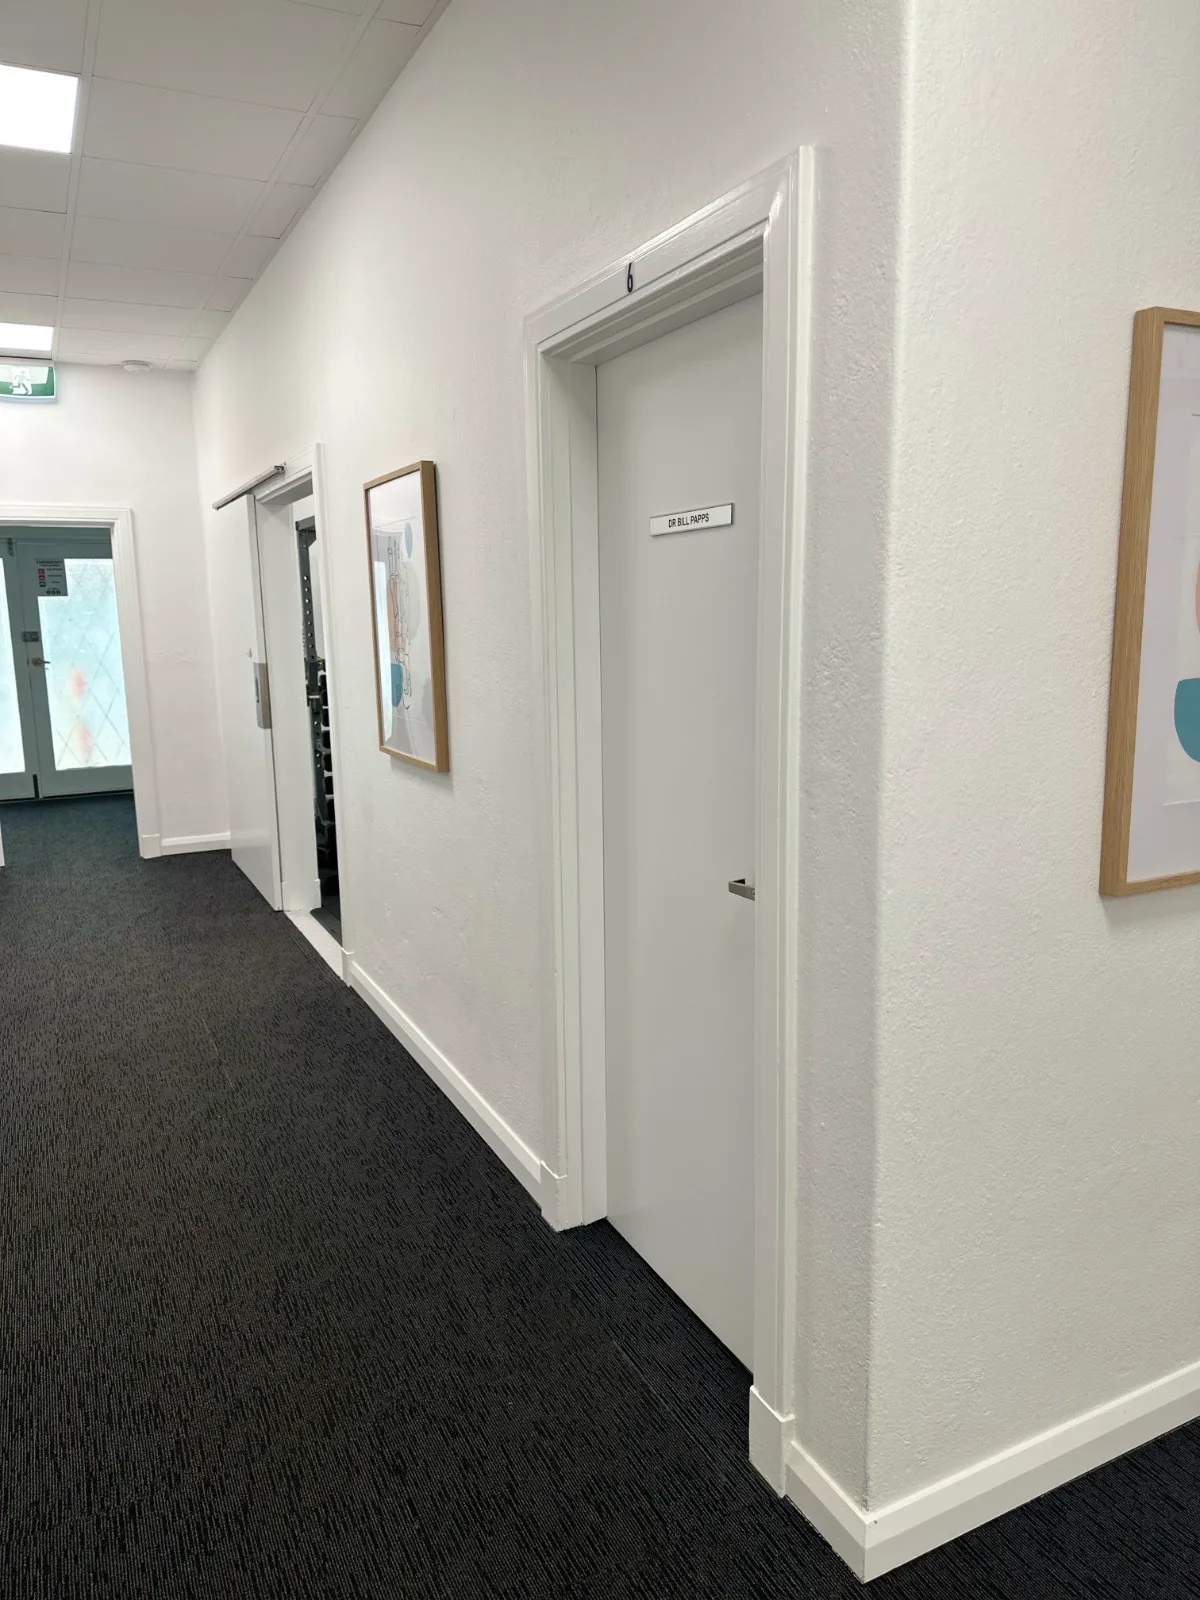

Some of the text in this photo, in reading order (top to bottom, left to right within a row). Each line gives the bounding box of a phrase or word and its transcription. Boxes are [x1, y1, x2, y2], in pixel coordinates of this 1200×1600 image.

[627, 262, 633, 292] 6
[668, 512, 709, 528] DR BILL PAPPS
